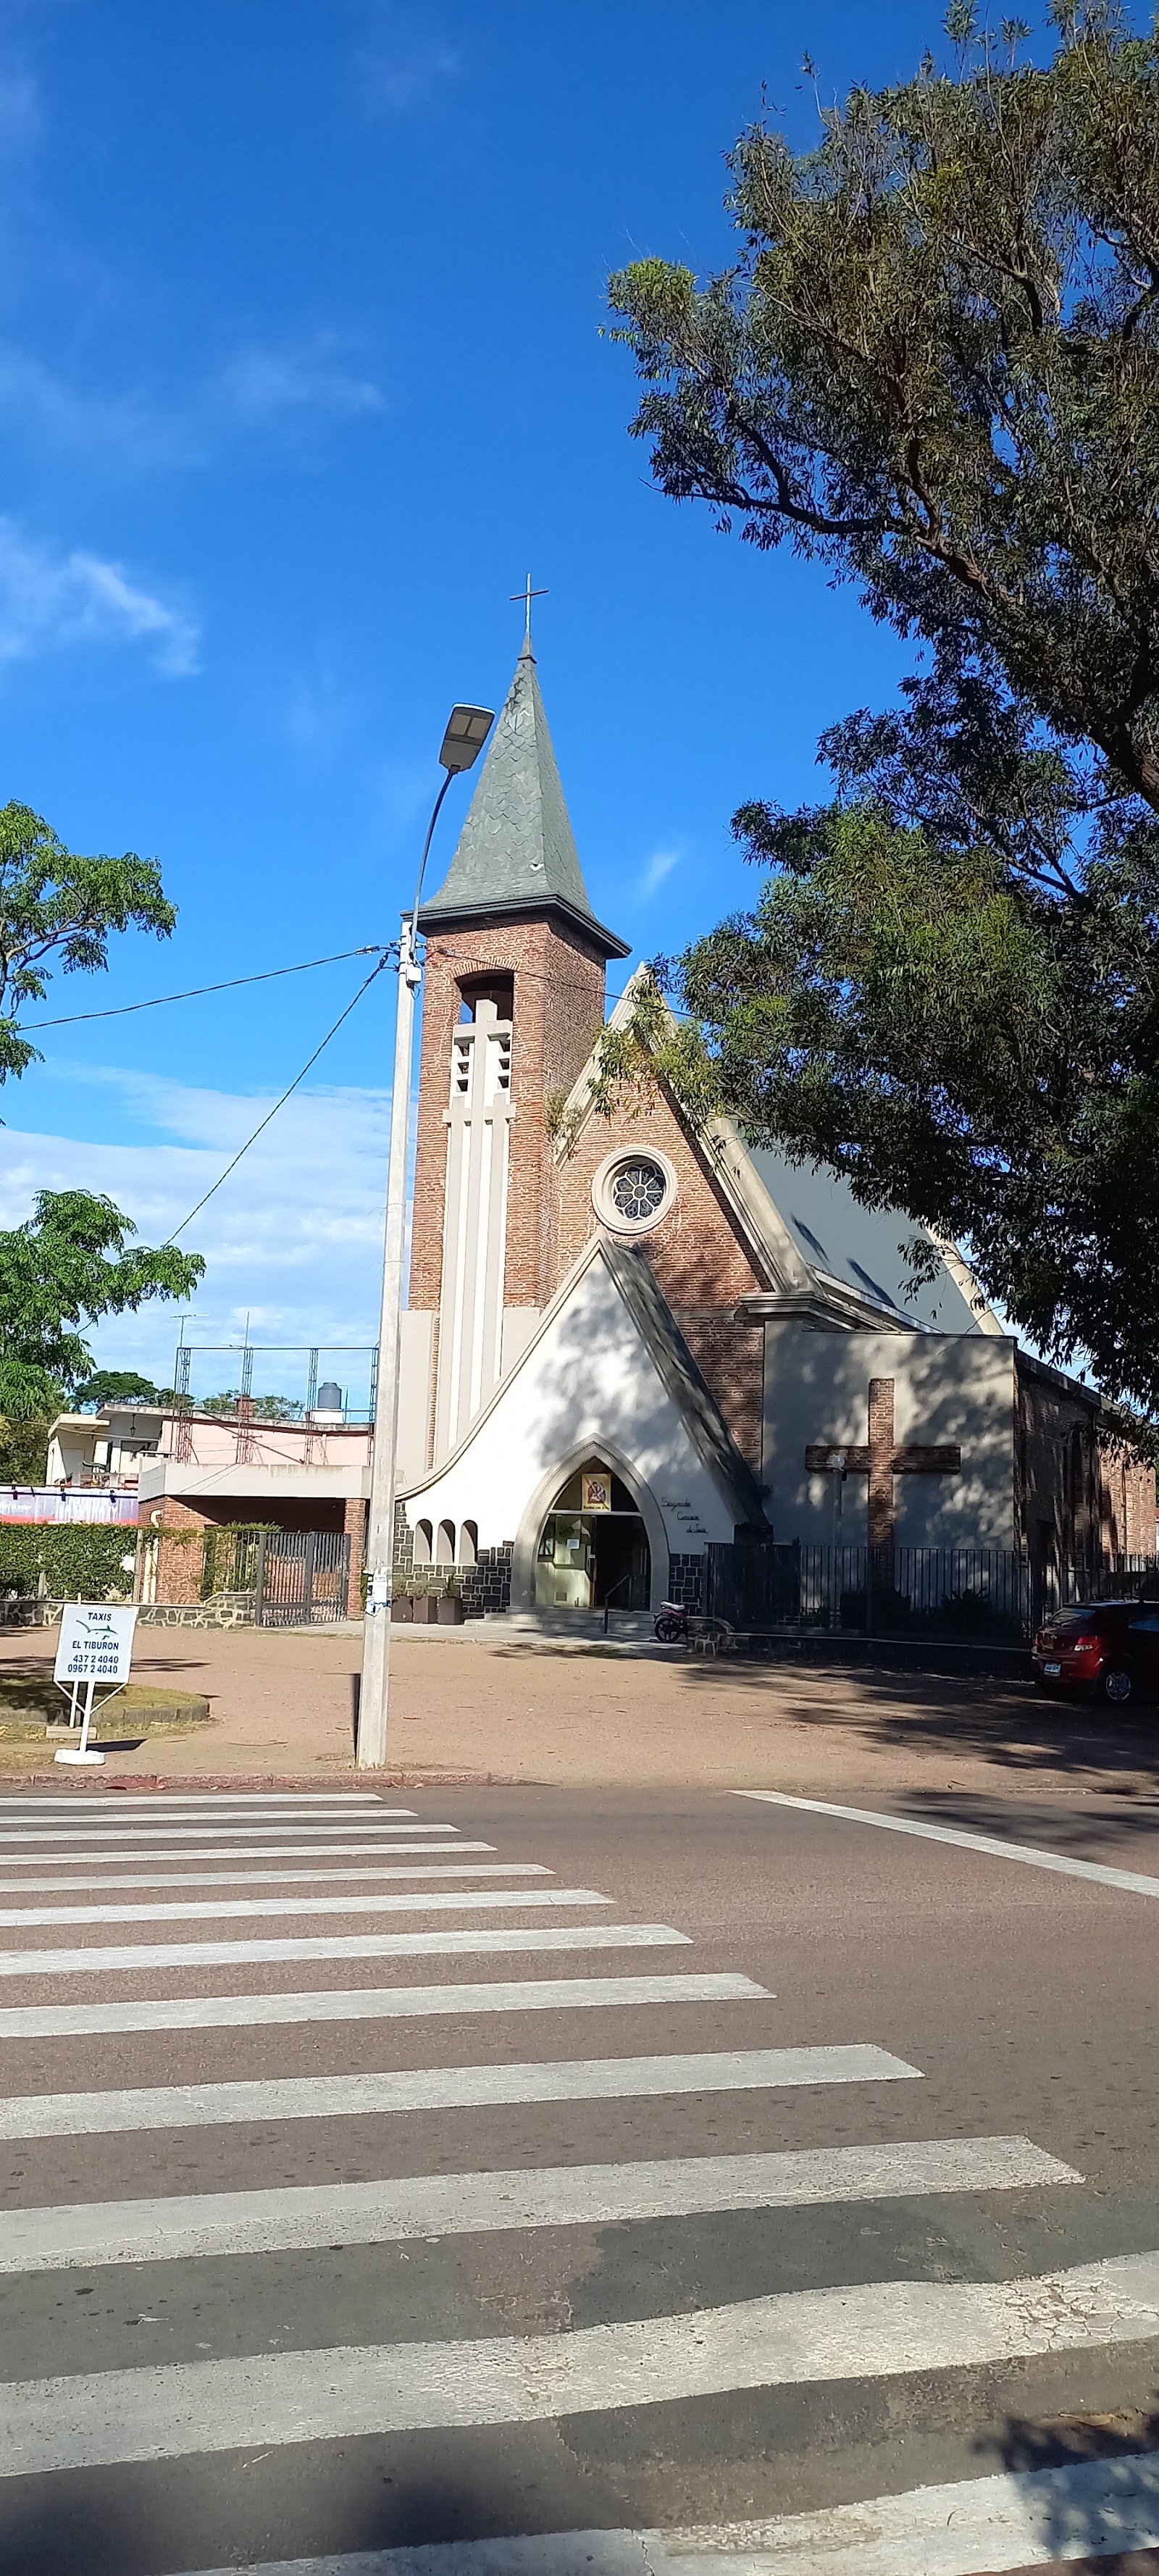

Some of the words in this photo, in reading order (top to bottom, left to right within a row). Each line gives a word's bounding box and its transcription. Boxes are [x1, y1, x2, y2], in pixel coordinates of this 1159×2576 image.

[88, 1613, 112, 1621] TAXIS
[84, 1642, 119, 1650] TIBURON
[73, 1655, 89, 1663] 437
[67, 1664, 88, 1673] 0967
[90, 1665, 95, 1673] 2
